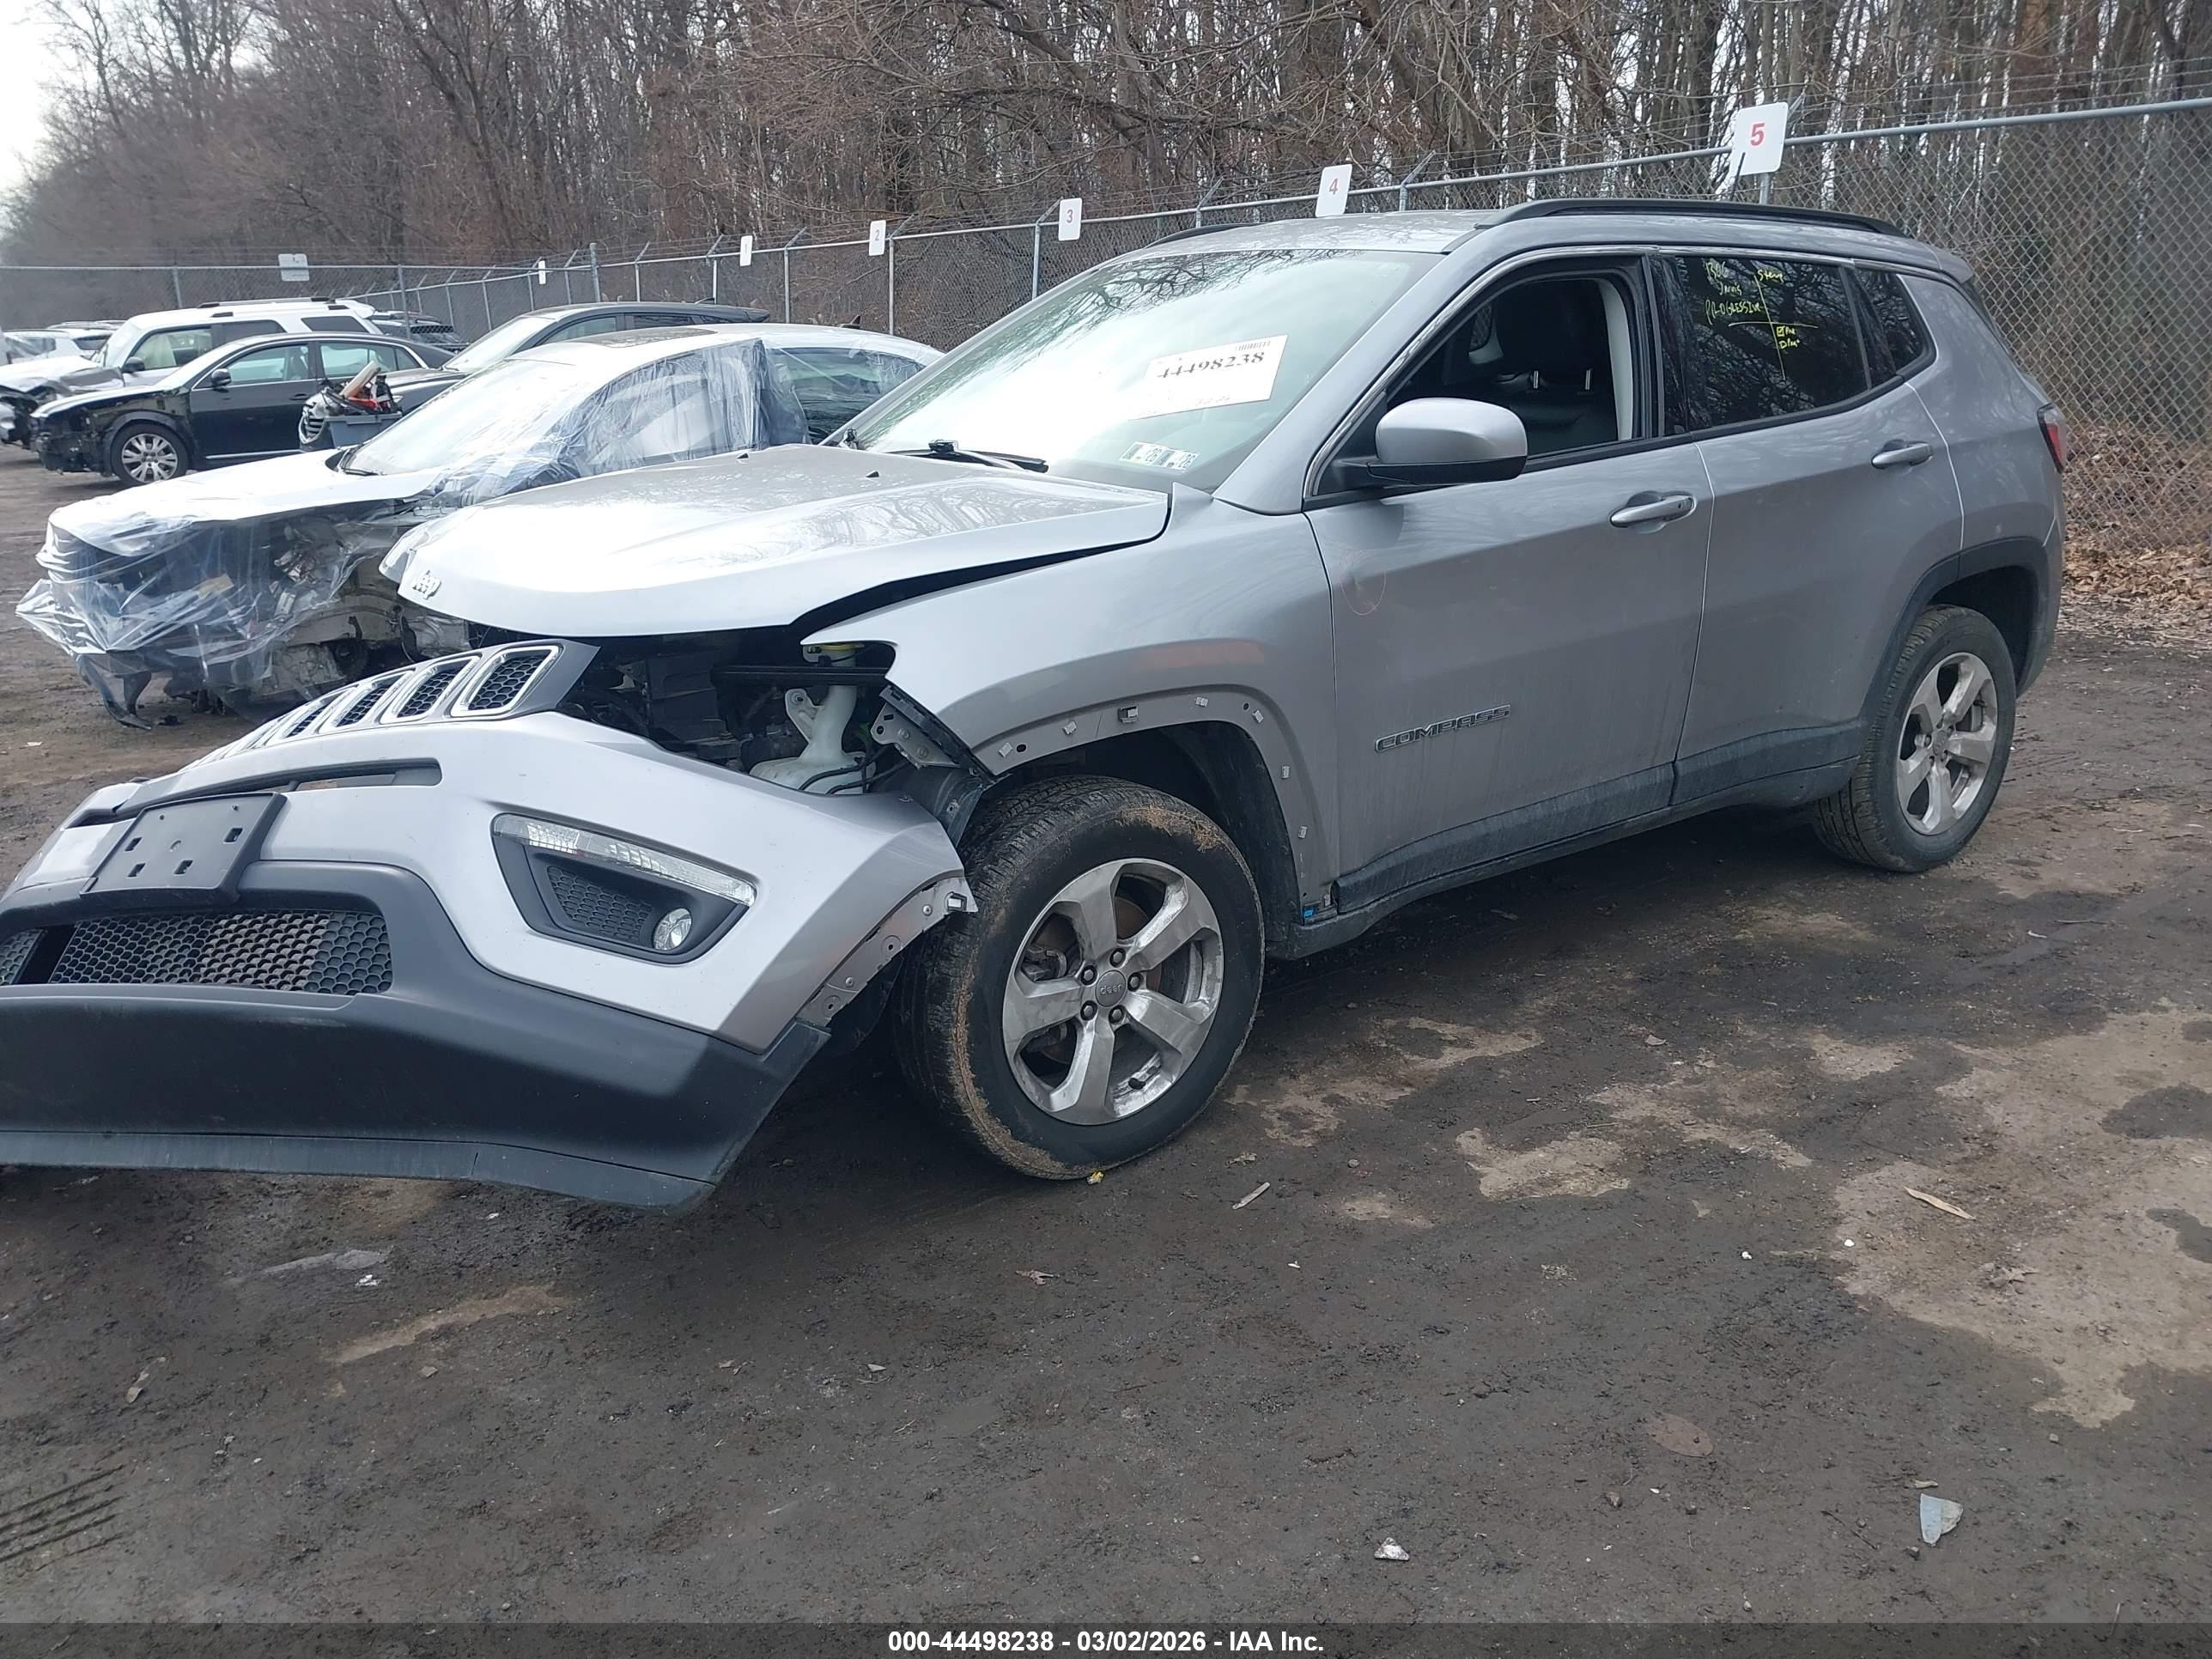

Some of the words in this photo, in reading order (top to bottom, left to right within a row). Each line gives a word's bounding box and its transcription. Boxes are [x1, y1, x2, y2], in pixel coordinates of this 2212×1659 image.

[1750, 123, 1765, 146] 5
[1328, 178, 1339, 195] 4
[1066, 209, 1073, 223] 3
[874, 229, 880, 241] 2
[1157, 351, 1265, 379] 44498238
[1374, 704, 1510, 753] COMPASS
